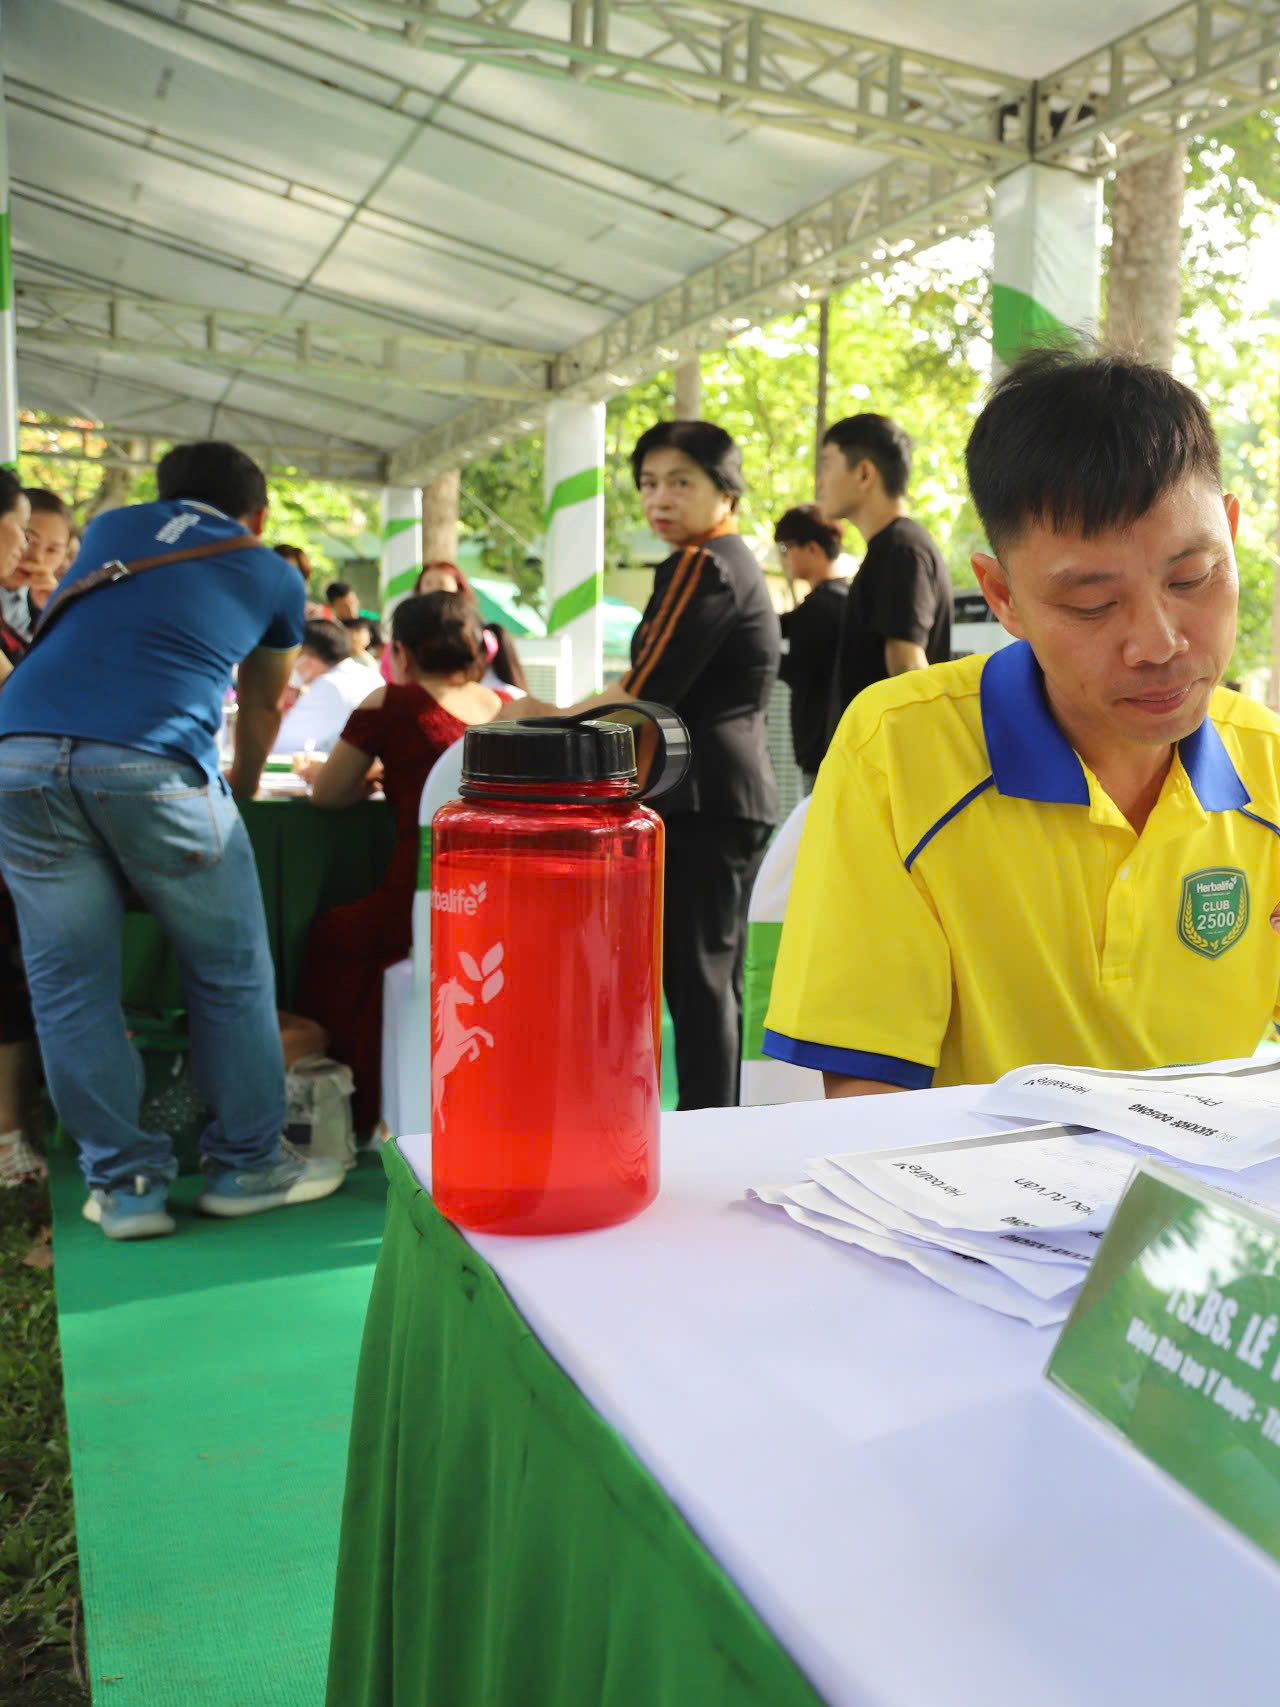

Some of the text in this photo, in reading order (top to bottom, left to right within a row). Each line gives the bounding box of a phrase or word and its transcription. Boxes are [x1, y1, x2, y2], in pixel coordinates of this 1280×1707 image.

[1196, 880, 1234, 894] Herbalife
[431, 885, 478, 916] balife
[1202, 900, 1230, 912] CLUB
[1197, 911, 1235, 930] 2500
[1036, 1076, 1092, 1095] Herbalife
[909, 1164, 967, 1197] Herbalife
[1236, 1313, 1279, 1370] LÊ
